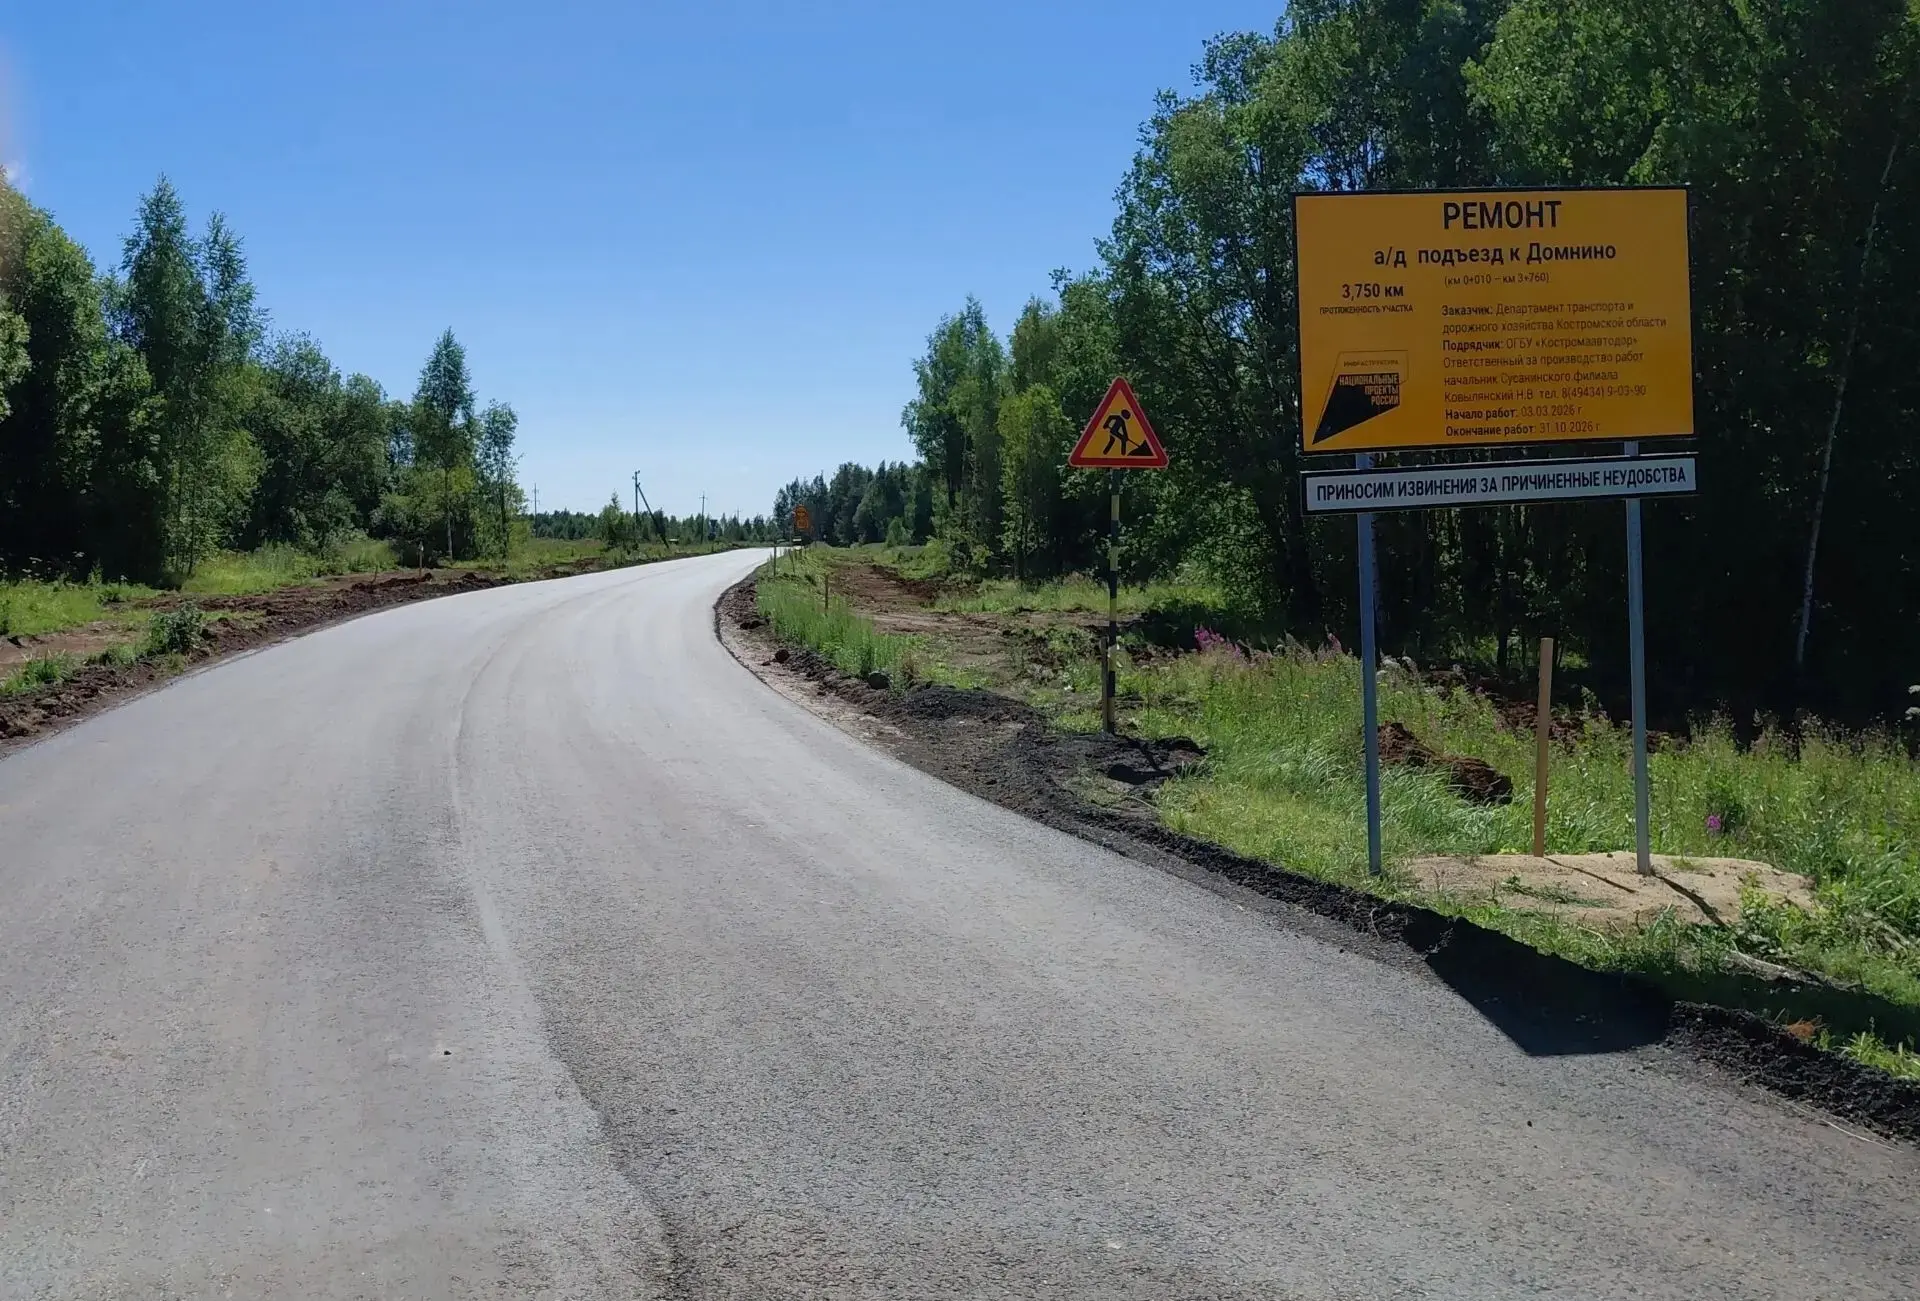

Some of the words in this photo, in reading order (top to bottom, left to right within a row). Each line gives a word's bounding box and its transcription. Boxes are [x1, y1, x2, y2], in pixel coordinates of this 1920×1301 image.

[1443, 200, 1561, 229] РЕМОНТ
[1374, 247, 1407, 268] а/д
[1418, 247, 1504, 267] подъезд
[1510, 249, 1520, 262] к
[1526, 242, 1616, 265] Домнино
[1444, 276, 1461, 287] (км
[1463, 274, 1492, 285] 0+010
[1502, 275, 1516, 285] км
[1517, 272, 1550, 284] 3+760)
[1342, 283, 1381, 301] 3,750
[1384, 286, 1404, 297] км
[1382, 304, 1413, 313] УЧАСТКА
[1441, 304, 1493, 316] Заказчик:
[1496, 303, 1564, 317] Департамент
[1567, 302, 1625, 315] транспорта
[1627, 303, 1635, 311] и
[1443, 322, 1498, 336] дорожного
[1501, 319, 1554, 331] хозяйства
[1557, 317, 1624, 331] Костромской
[1626, 316, 1667, 328] области
[1443, 340, 1504, 353] Подрядчик:
[1507, 337, 1533, 349] ОГБУ
[1443, 355, 1523, 369] Ответственный
[1526, 358, 1538, 366] за
[1540, 354, 1612, 366] производство
[1615, 351, 1644, 364] работ
[1339, 374, 1399, 386] НАЦИОНАЛЬНЫЕ
[1444, 375, 1498, 385] начальник
[1501, 372, 1570, 386] Сусанинского
[1573, 369, 1618, 383] филиала
[1364, 384, 1399, 396] ПРОЕКТЫ
[1371, 395, 1399, 406] РОССИИ
[1445, 408, 1482, 420] Начало
[1446, 424, 1501, 436] Окончание
[1317, 481, 1394, 501] ПРИНОСИМ
[1398, 477, 1477, 497] ИЗВИНЕНИЯ
[1480, 476, 1497, 493] ЗА
[1502, 470, 1600, 491] ПРИЧИНЕННЫЕ
[1603, 466, 1686, 488] НЕУДОБСТВА
